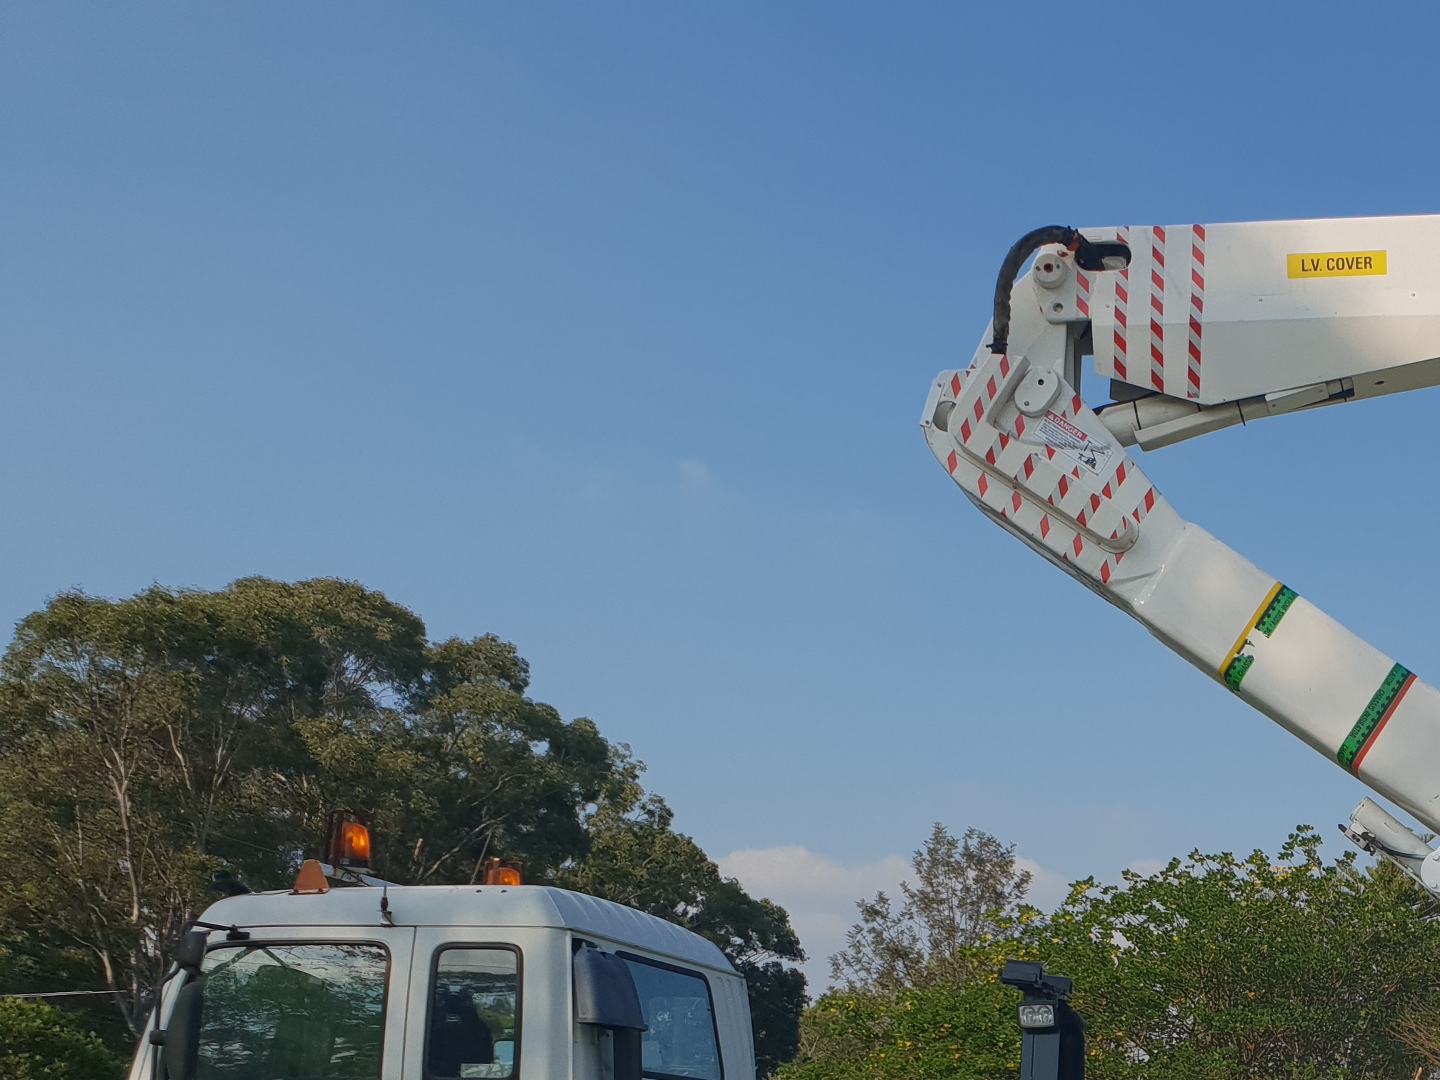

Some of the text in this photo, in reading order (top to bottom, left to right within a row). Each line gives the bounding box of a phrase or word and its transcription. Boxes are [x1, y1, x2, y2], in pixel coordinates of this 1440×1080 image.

[1301, 256, 1373, 272] L.V. COVER
[1053, 416, 1083, 438] DANGER
